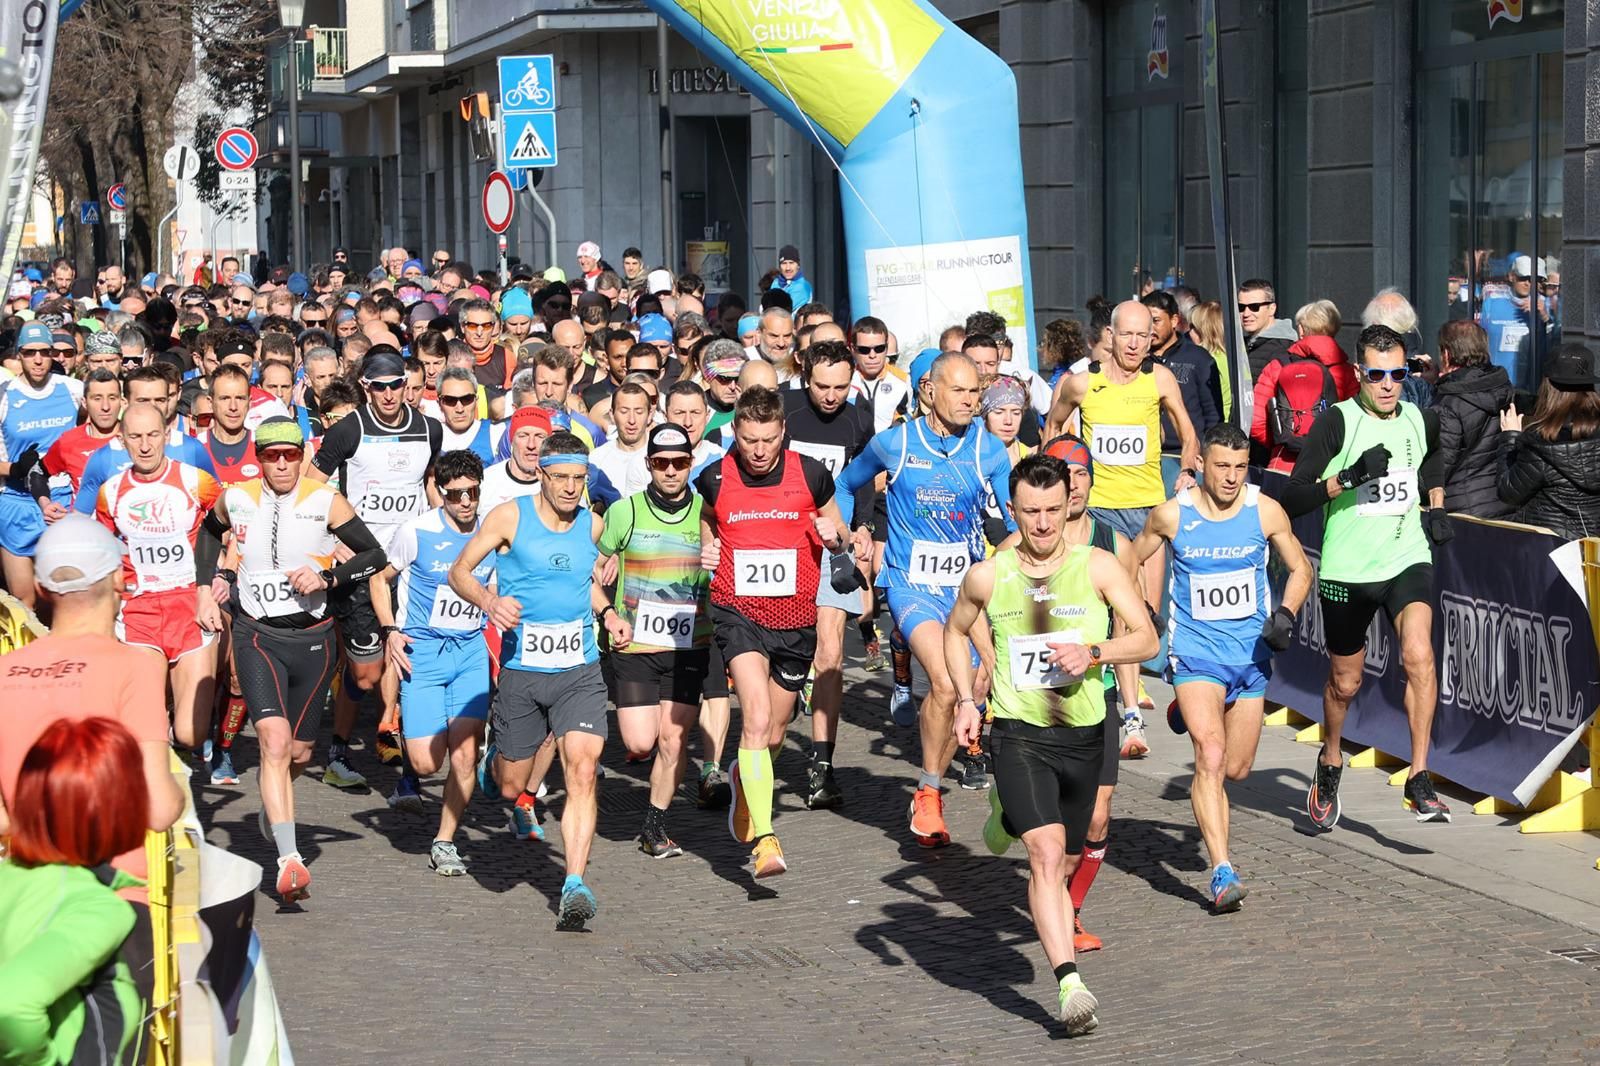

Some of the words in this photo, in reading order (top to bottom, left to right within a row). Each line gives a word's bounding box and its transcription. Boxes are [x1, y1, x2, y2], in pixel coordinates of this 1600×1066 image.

[752, 21, 823, 42] GIULIA
[1096, 437, 1144, 454] 1060
[367, 494, 417, 512] 3007
[1368, 481, 1409, 504] 395
[726, 508, 799, 525] JalmiccoCorse
[914, 508, 964, 521] ITALIA
[135, 544, 184, 564] 1199
[918, 554, 966, 575] 1149
[745, 563, 786, 584] 210
[249, 580, 300, 603] 305
[1196, 583, 1250, 608] 1001
[641, 613, 691, 637] 1096
[525, 631, 581, 655] 3046
[1020, 649, 1055, 675] 75
[1440, 590, 1584, 737] FRUCTAL
